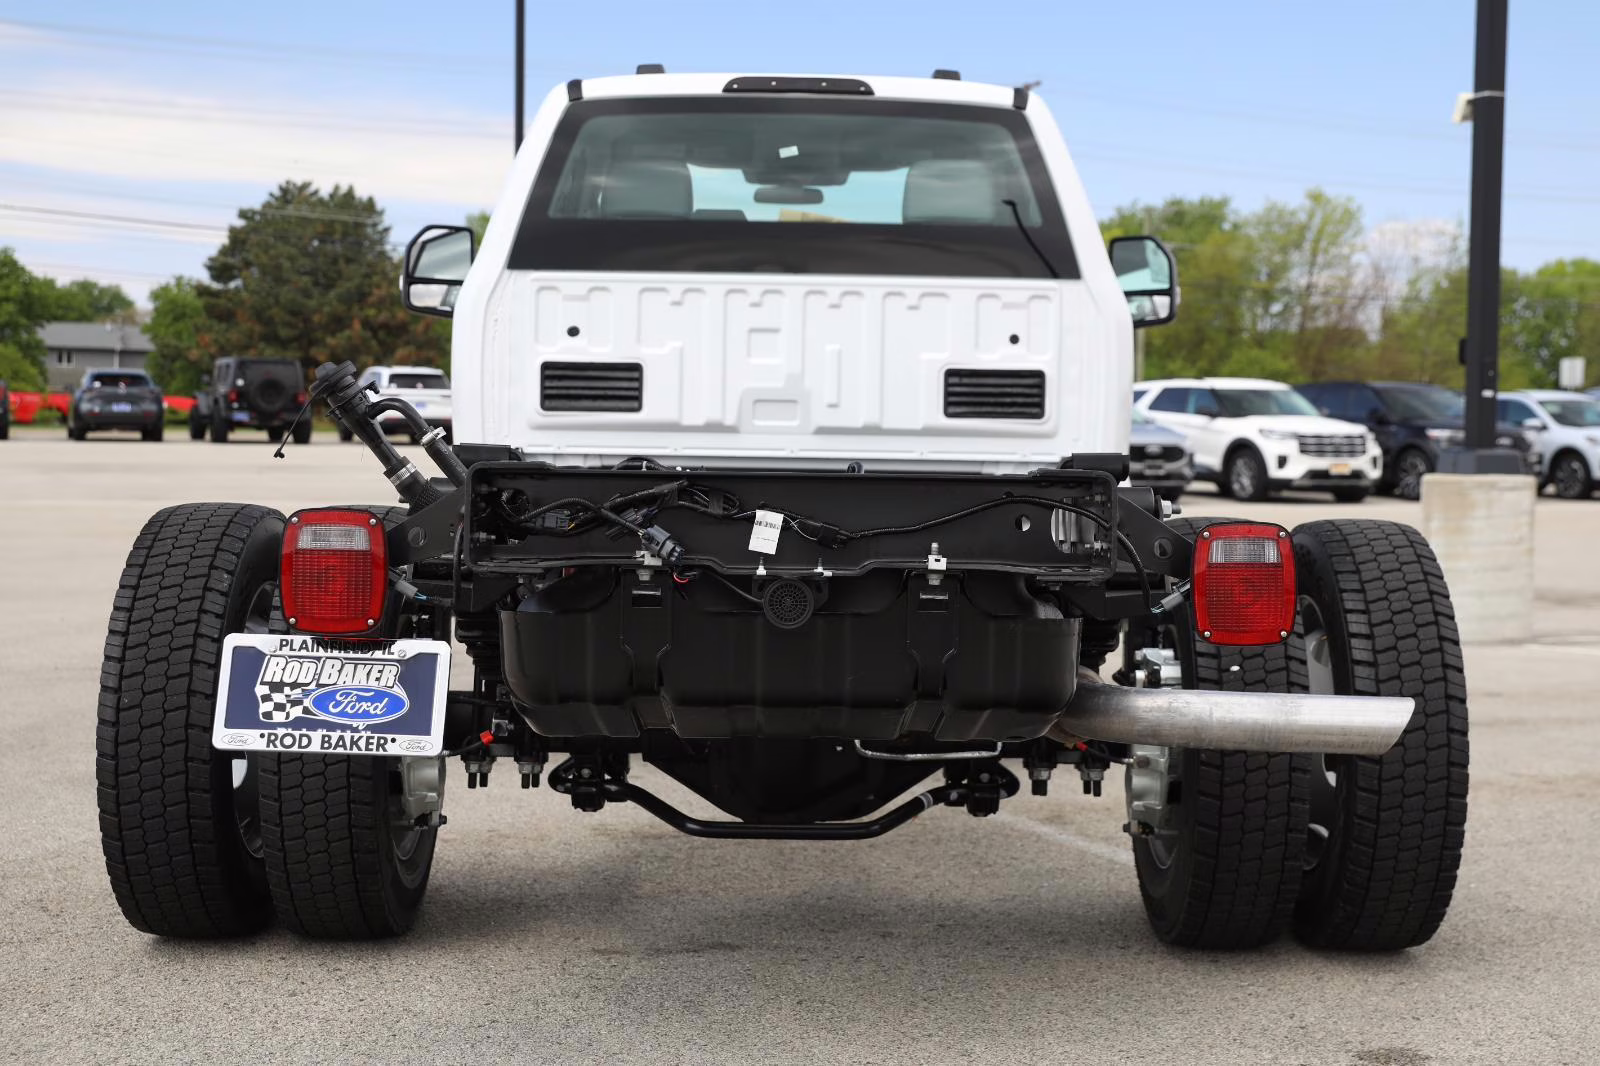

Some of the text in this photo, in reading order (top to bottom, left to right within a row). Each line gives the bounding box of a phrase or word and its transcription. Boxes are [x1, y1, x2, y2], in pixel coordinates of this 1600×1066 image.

[261, 656, 399, 689] ROD BAKER
[328, 690, 389, 715] Ford
[266, 732, 389, 753] ROD BAKER
